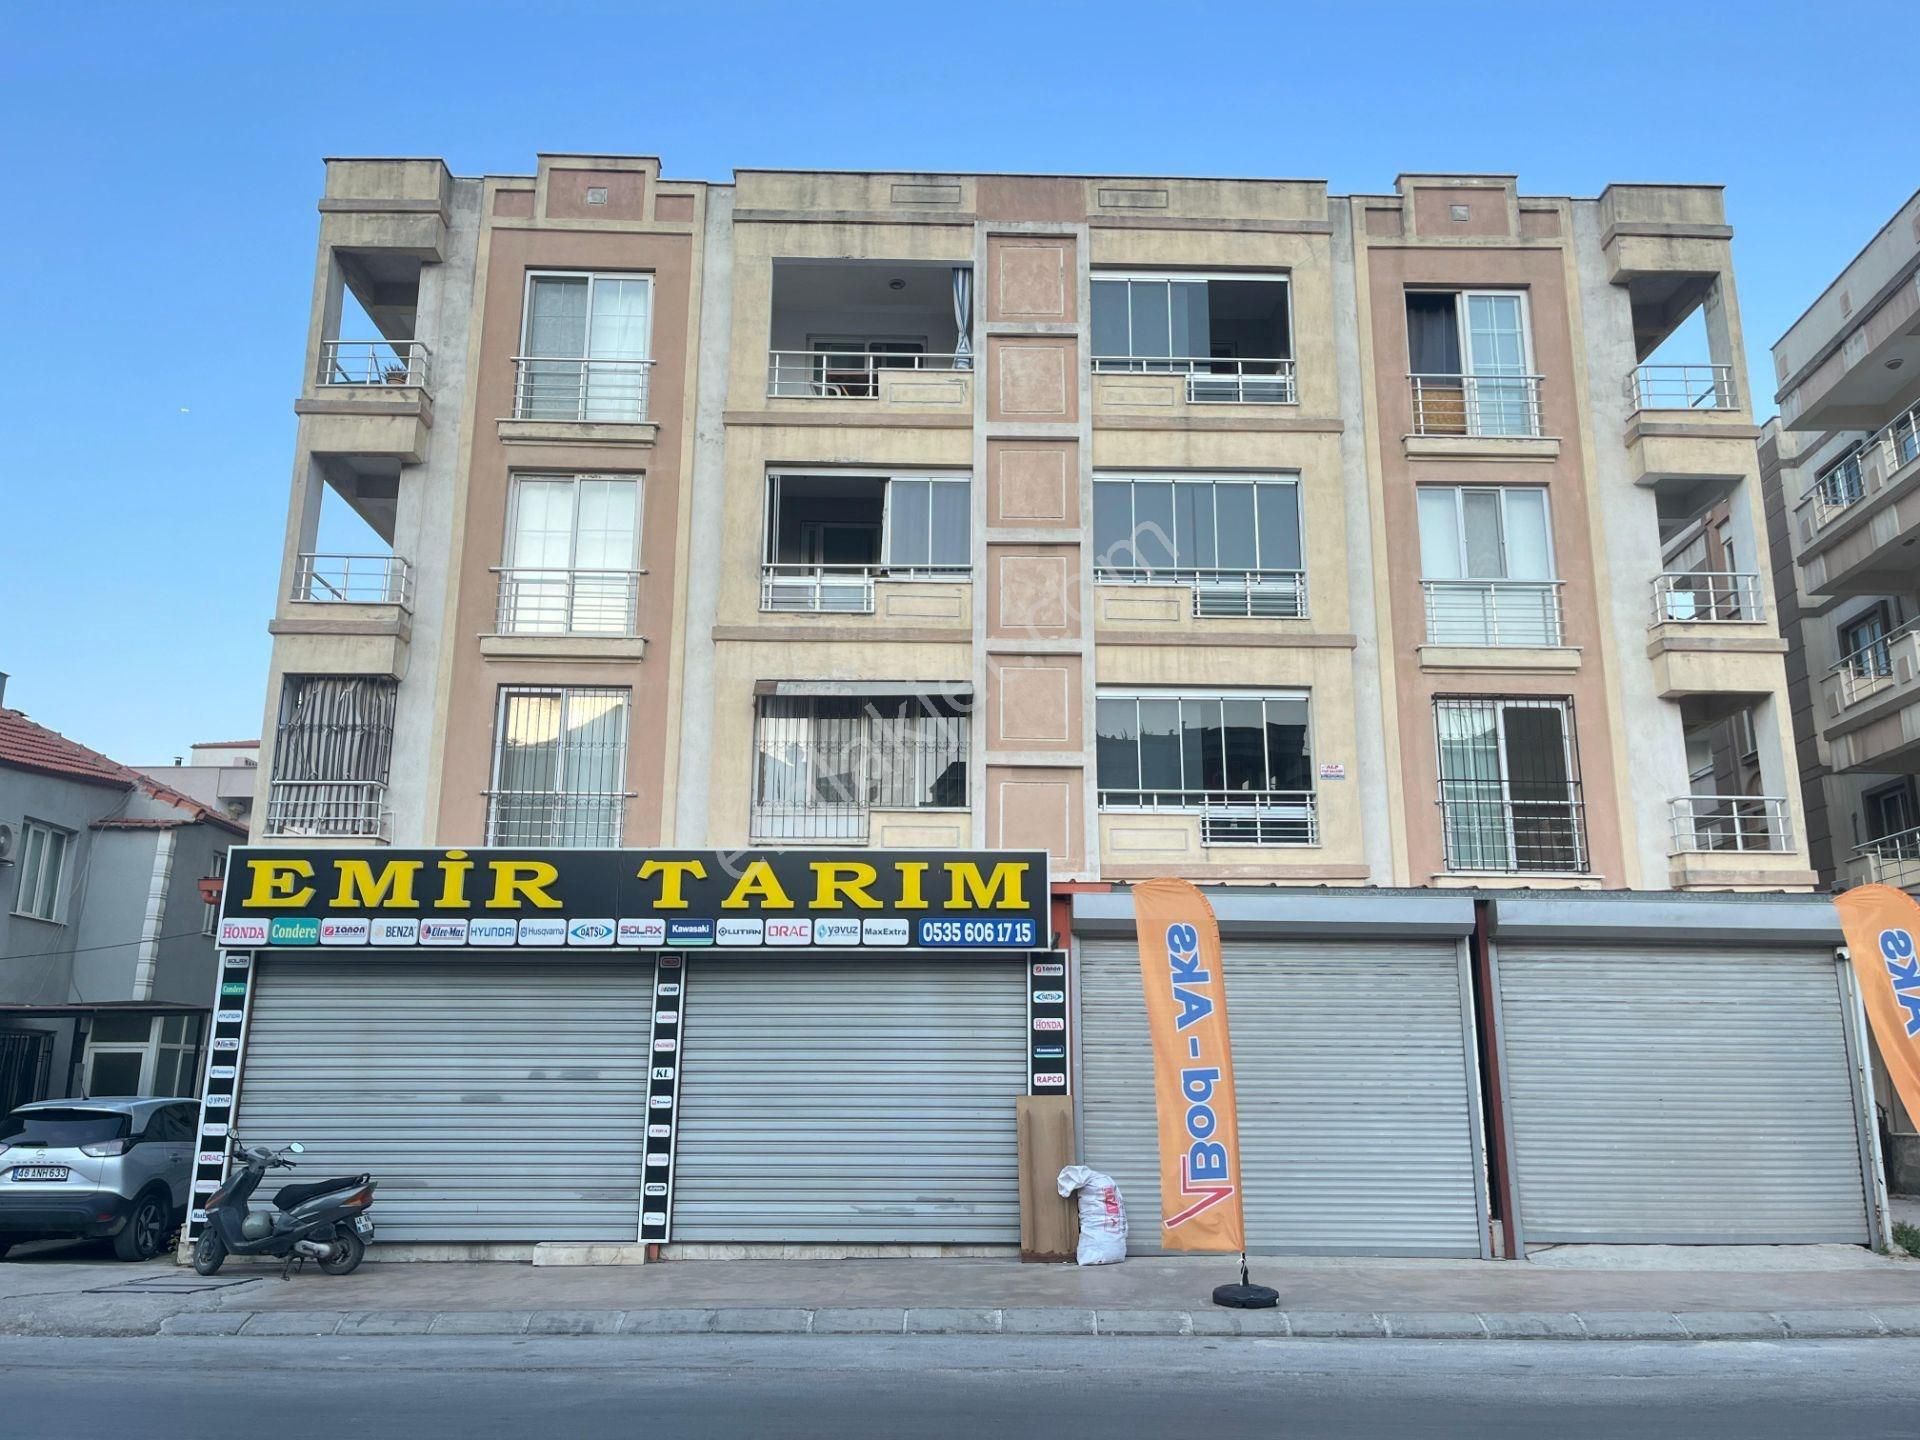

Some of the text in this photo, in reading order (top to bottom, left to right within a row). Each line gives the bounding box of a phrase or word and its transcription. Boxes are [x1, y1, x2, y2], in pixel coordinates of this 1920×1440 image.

[242, 850, 1030, 910] EMİR TARIM
[223, 926, 265, 939] HONDA
[272, 923, 317, 939] Condere
[386, 926, 414, 938] BENZA
[470, 927, 515, 937] HYUNDAI
[672, 924, 710, 934] Kawasaki
[828, 925, 858, 936] yavuz
[864, 927, 907, 936] MaxExtra
[923, 922, 1031, 943] 0535 606 17 15
[1036, 1021, 1062, 1029] HONDA
[1036, 1075, 1063, 1083] RAPCO
[49, 1167, 67, 1177] 633
